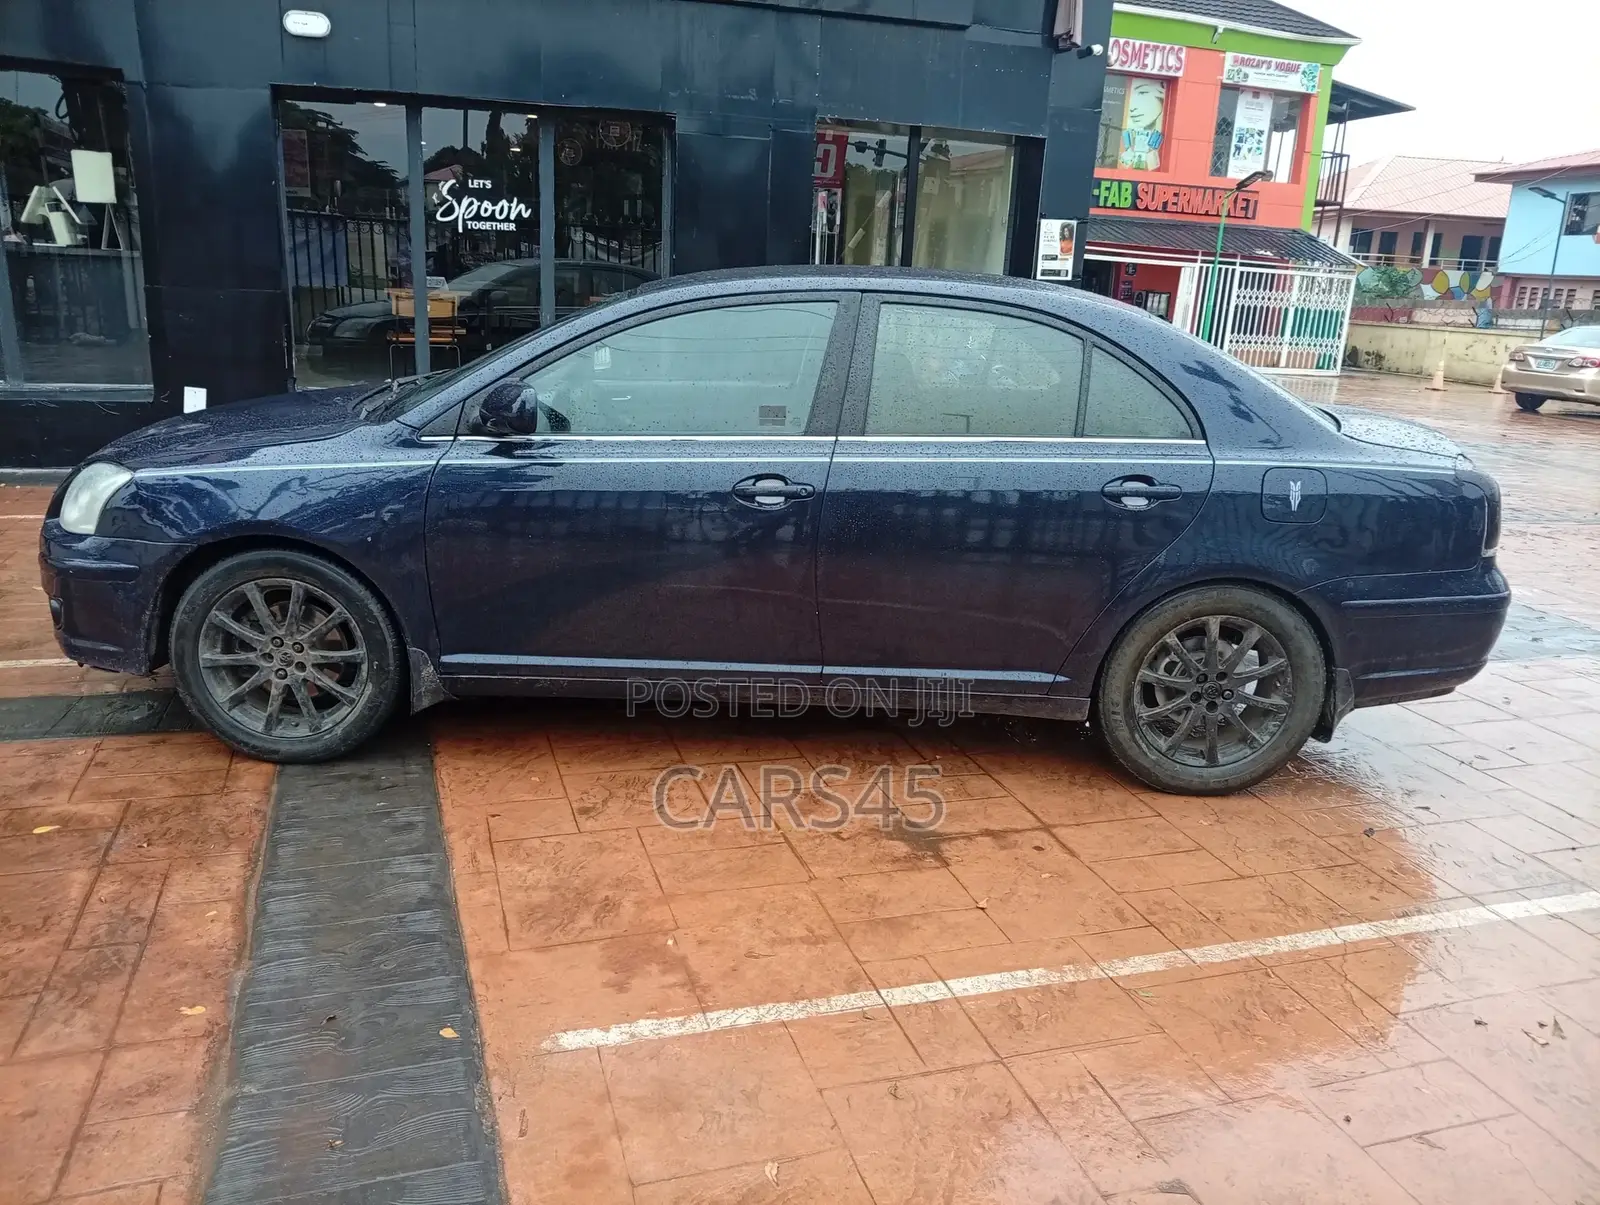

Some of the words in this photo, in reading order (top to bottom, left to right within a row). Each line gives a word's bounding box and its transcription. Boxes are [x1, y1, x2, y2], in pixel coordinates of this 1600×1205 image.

[1274, 60, 1302, 73] VOGUE
[468, 178, 492, 190] LET'S
[435, 178, 532, 233] Spoon
[1135, 182, 1258, 218] SUPERMARKET
[466, 220, 517, 232] TOGETHER
